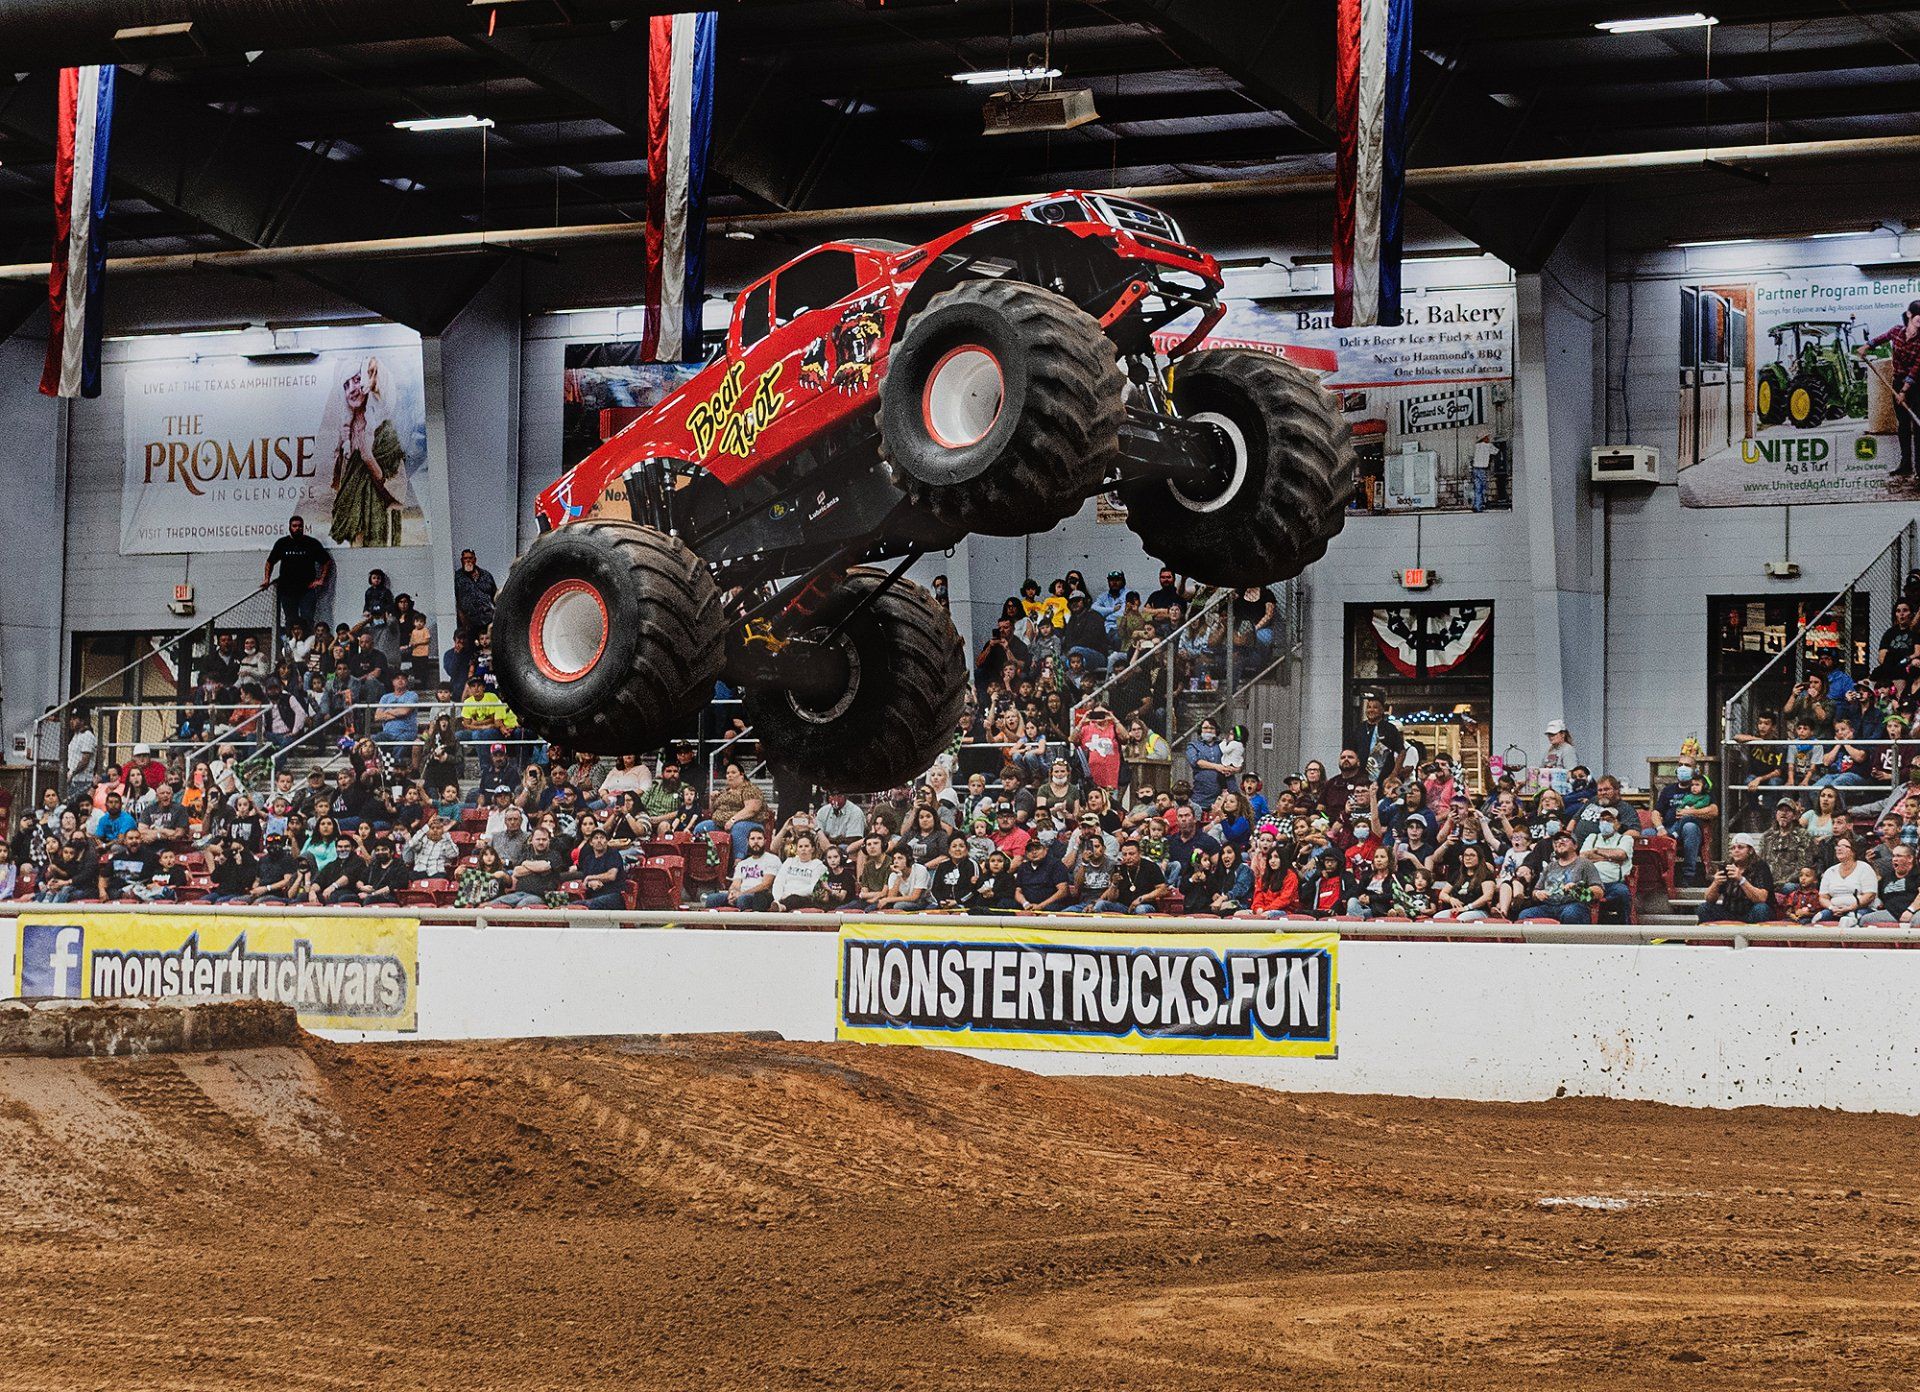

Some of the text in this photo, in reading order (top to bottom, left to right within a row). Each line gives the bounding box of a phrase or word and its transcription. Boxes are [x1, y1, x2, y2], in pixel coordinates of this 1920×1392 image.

[1757, 287, 1807, 301] Partner
[1811, 284, 1868, 301] Program
[1427, 304, 1506, 326] Bakery
[1757, 308, 1781, 316] Savings
[1793, 306, 1814, 314] Equine
[1828, 305, 1837, 313] Ag
[1837, 303, 1873, 311] Association
[1340, 330, 1503, 347] Deli Beer Ice Fuel ATM
[1373, 349, 1503, 364] Next to Hammond's BBQ
[1393, 364, 1503, 377] One block west of arena
[143, 375, 317, 395] LIVE AT THE TEXAS AMPHITHEATER
[686, 361, 746, 459] Bear
[719, 361, 785, 459] Foot
[162, 414, 204, 436] THE
[1741, 438, 1829, 464] UNITED
[143, 435, 317, 496] PROMISE
[1785, 461, 1829, 475] Ag & Turf
[211, 486, 315, 501] IN GLEN ROSE
[138, 524, 313, 540] VISIT THEPROMISEGLENROSE.M
[1405, 569, 1424, 585] EXIT
[175, 585, 188, 599] EXIT
[93, 936, 401, 1007] monstertruckwars
[848, 946, 1320, 1028] MONSTERTRUCKS.FUN
